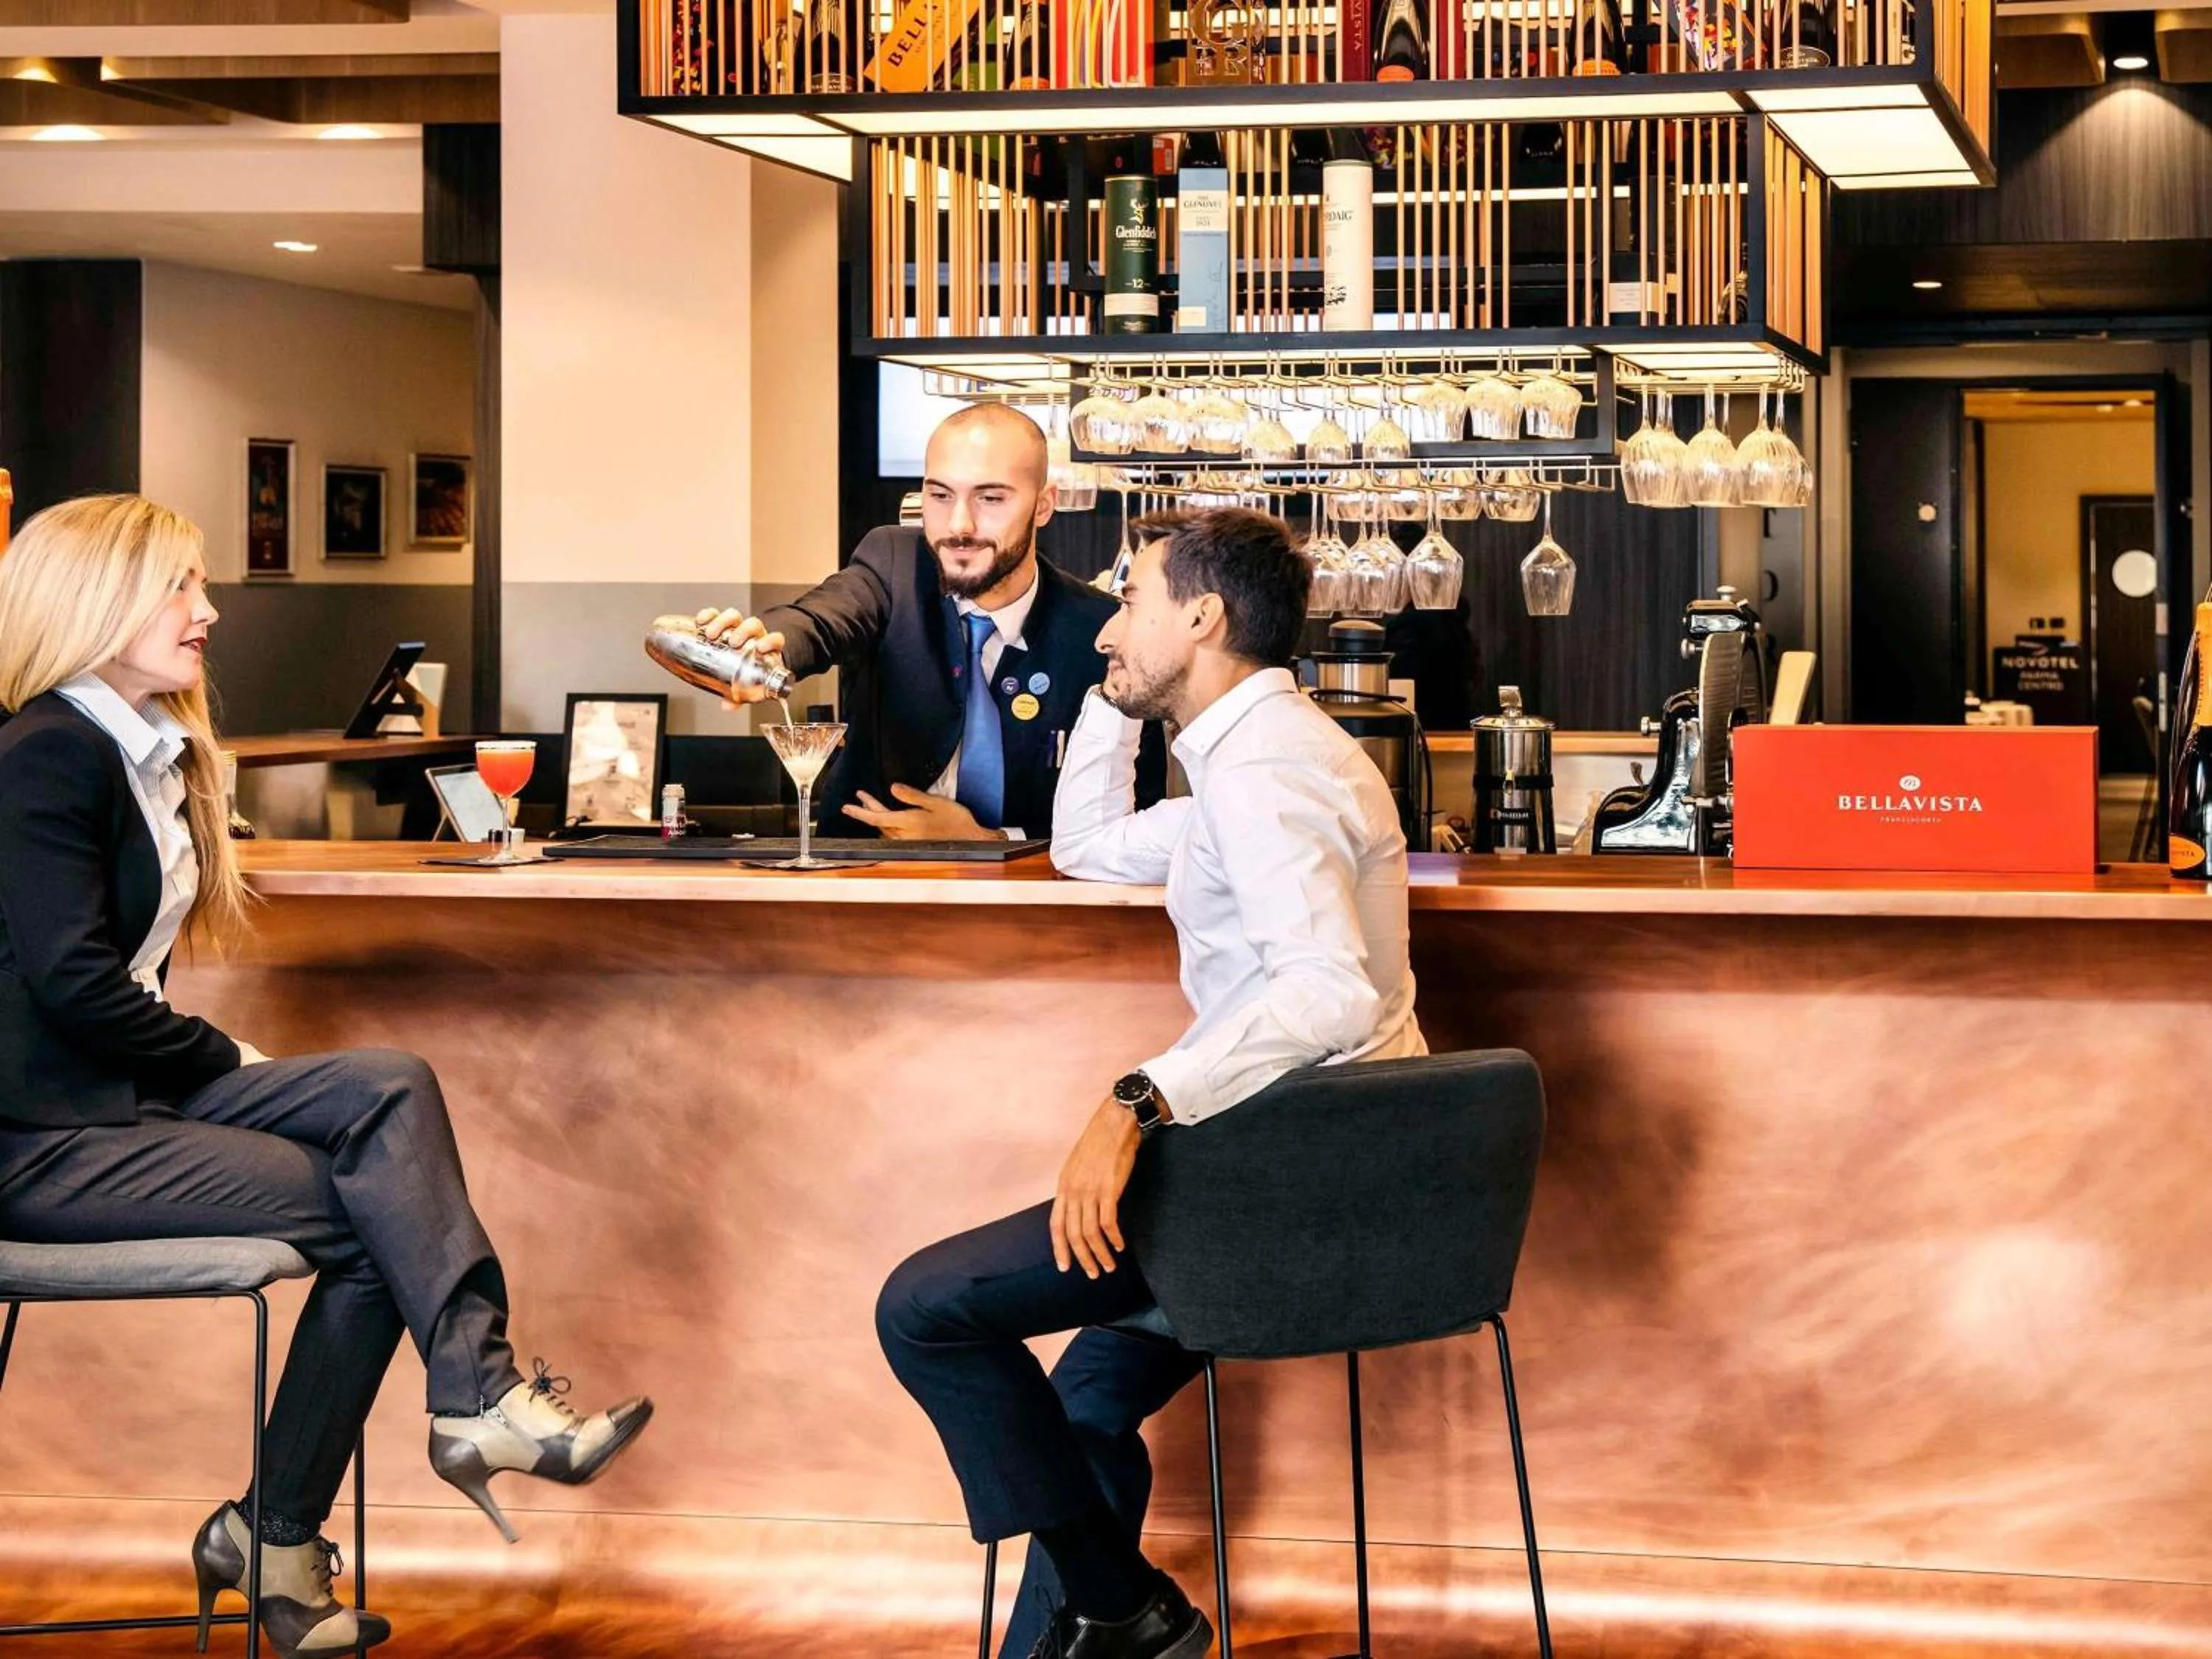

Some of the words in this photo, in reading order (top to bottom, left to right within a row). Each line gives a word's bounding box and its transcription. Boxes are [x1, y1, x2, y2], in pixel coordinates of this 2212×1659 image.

[1132, 279, 1144, 288] 12
[2002, 655, 2079, 669] NOVOTEL
[1838, 795, 1983, 812] BELLAVISTA
